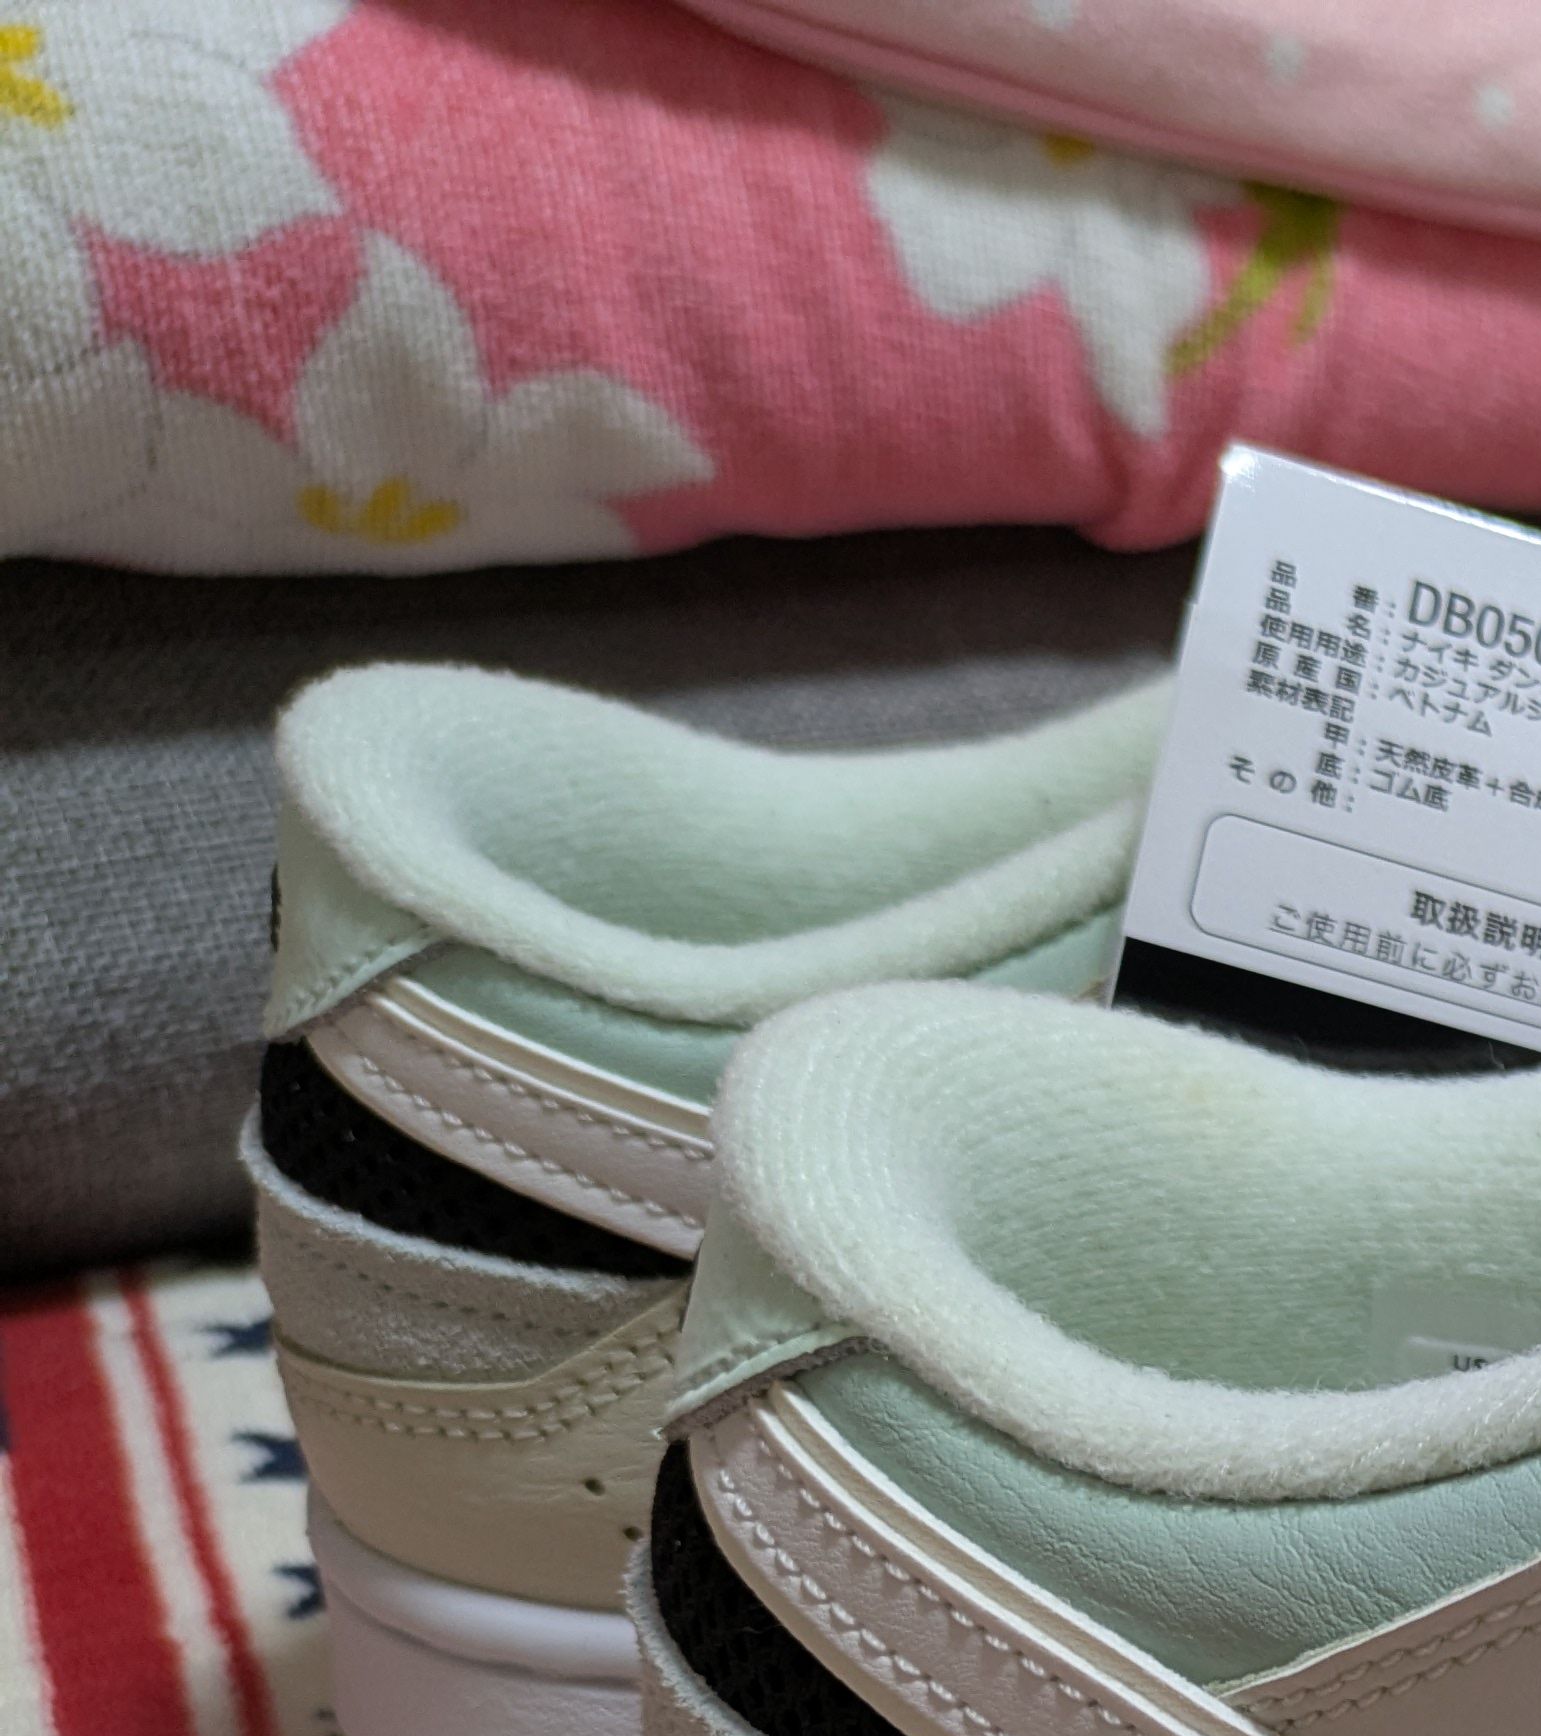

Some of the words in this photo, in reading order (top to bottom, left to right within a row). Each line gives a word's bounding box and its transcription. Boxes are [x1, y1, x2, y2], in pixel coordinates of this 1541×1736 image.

[1401, 632, 1479, 673] ナイキ
[1247, 668, 1356, 723] 素材表記
[1388, 686, 1492, 738] ベトナム
[1368, 767, 1452, 812] ゴム底
